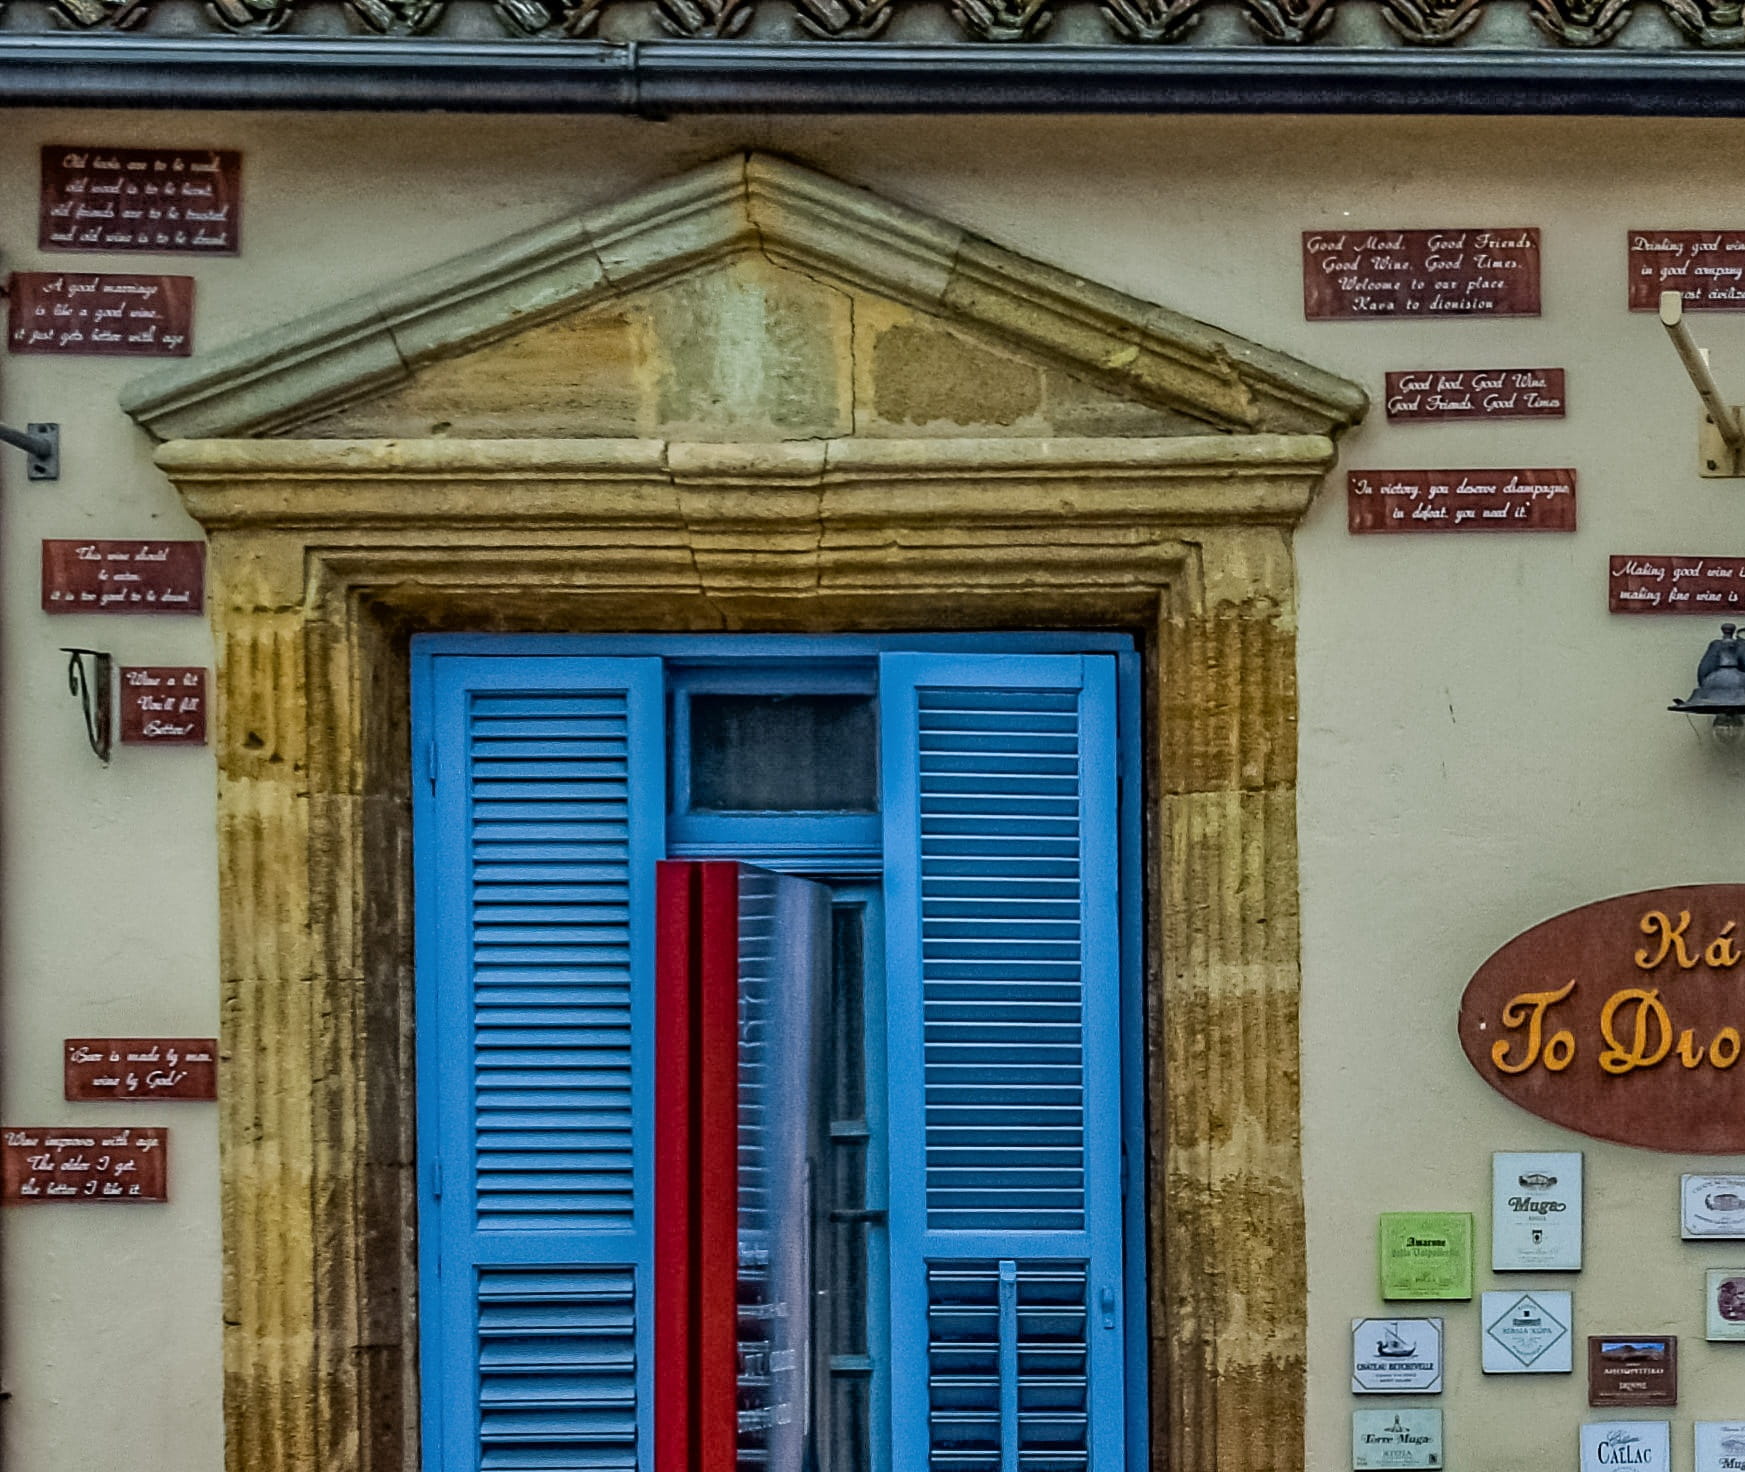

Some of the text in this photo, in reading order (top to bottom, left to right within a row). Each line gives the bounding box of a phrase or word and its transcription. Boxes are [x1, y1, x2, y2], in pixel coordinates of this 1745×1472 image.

[1305, 233, 1347, 254] Good
[1426, 232, 1467, 252] Good
[1630, 235, 1684, 257] Drinking
[1689, 233, 1722, 257] good
[1321, 253, 1362, 274] Good
[1423, 252, 1464, 273] Good
[1640, 263, 1653, 276] in
[1658, 258, 1691, 280] good
[1692, 266, 1743, 281] company
[1336, 274, 1401, 291] Welcome
[1410, 277, 1425, 290] to
[1433, 280, 1458, 290] our
[1351, 292, 1493, 311] Kava to dionision
[1611, 558, 1666, 582] Making
[1670, 558, 1704, 582] good
[1705, 565, 1734, 578] wine
[1618, 585, 1661, 606] making
[1667, 585, 1690, 603] fine
[1694, 589, 1722, 602] wine
[1726, 589, 1739, 602] is
[1491, 978, 1577, 1073] Το
[1507, 1196, 1567, 1216] Muga
